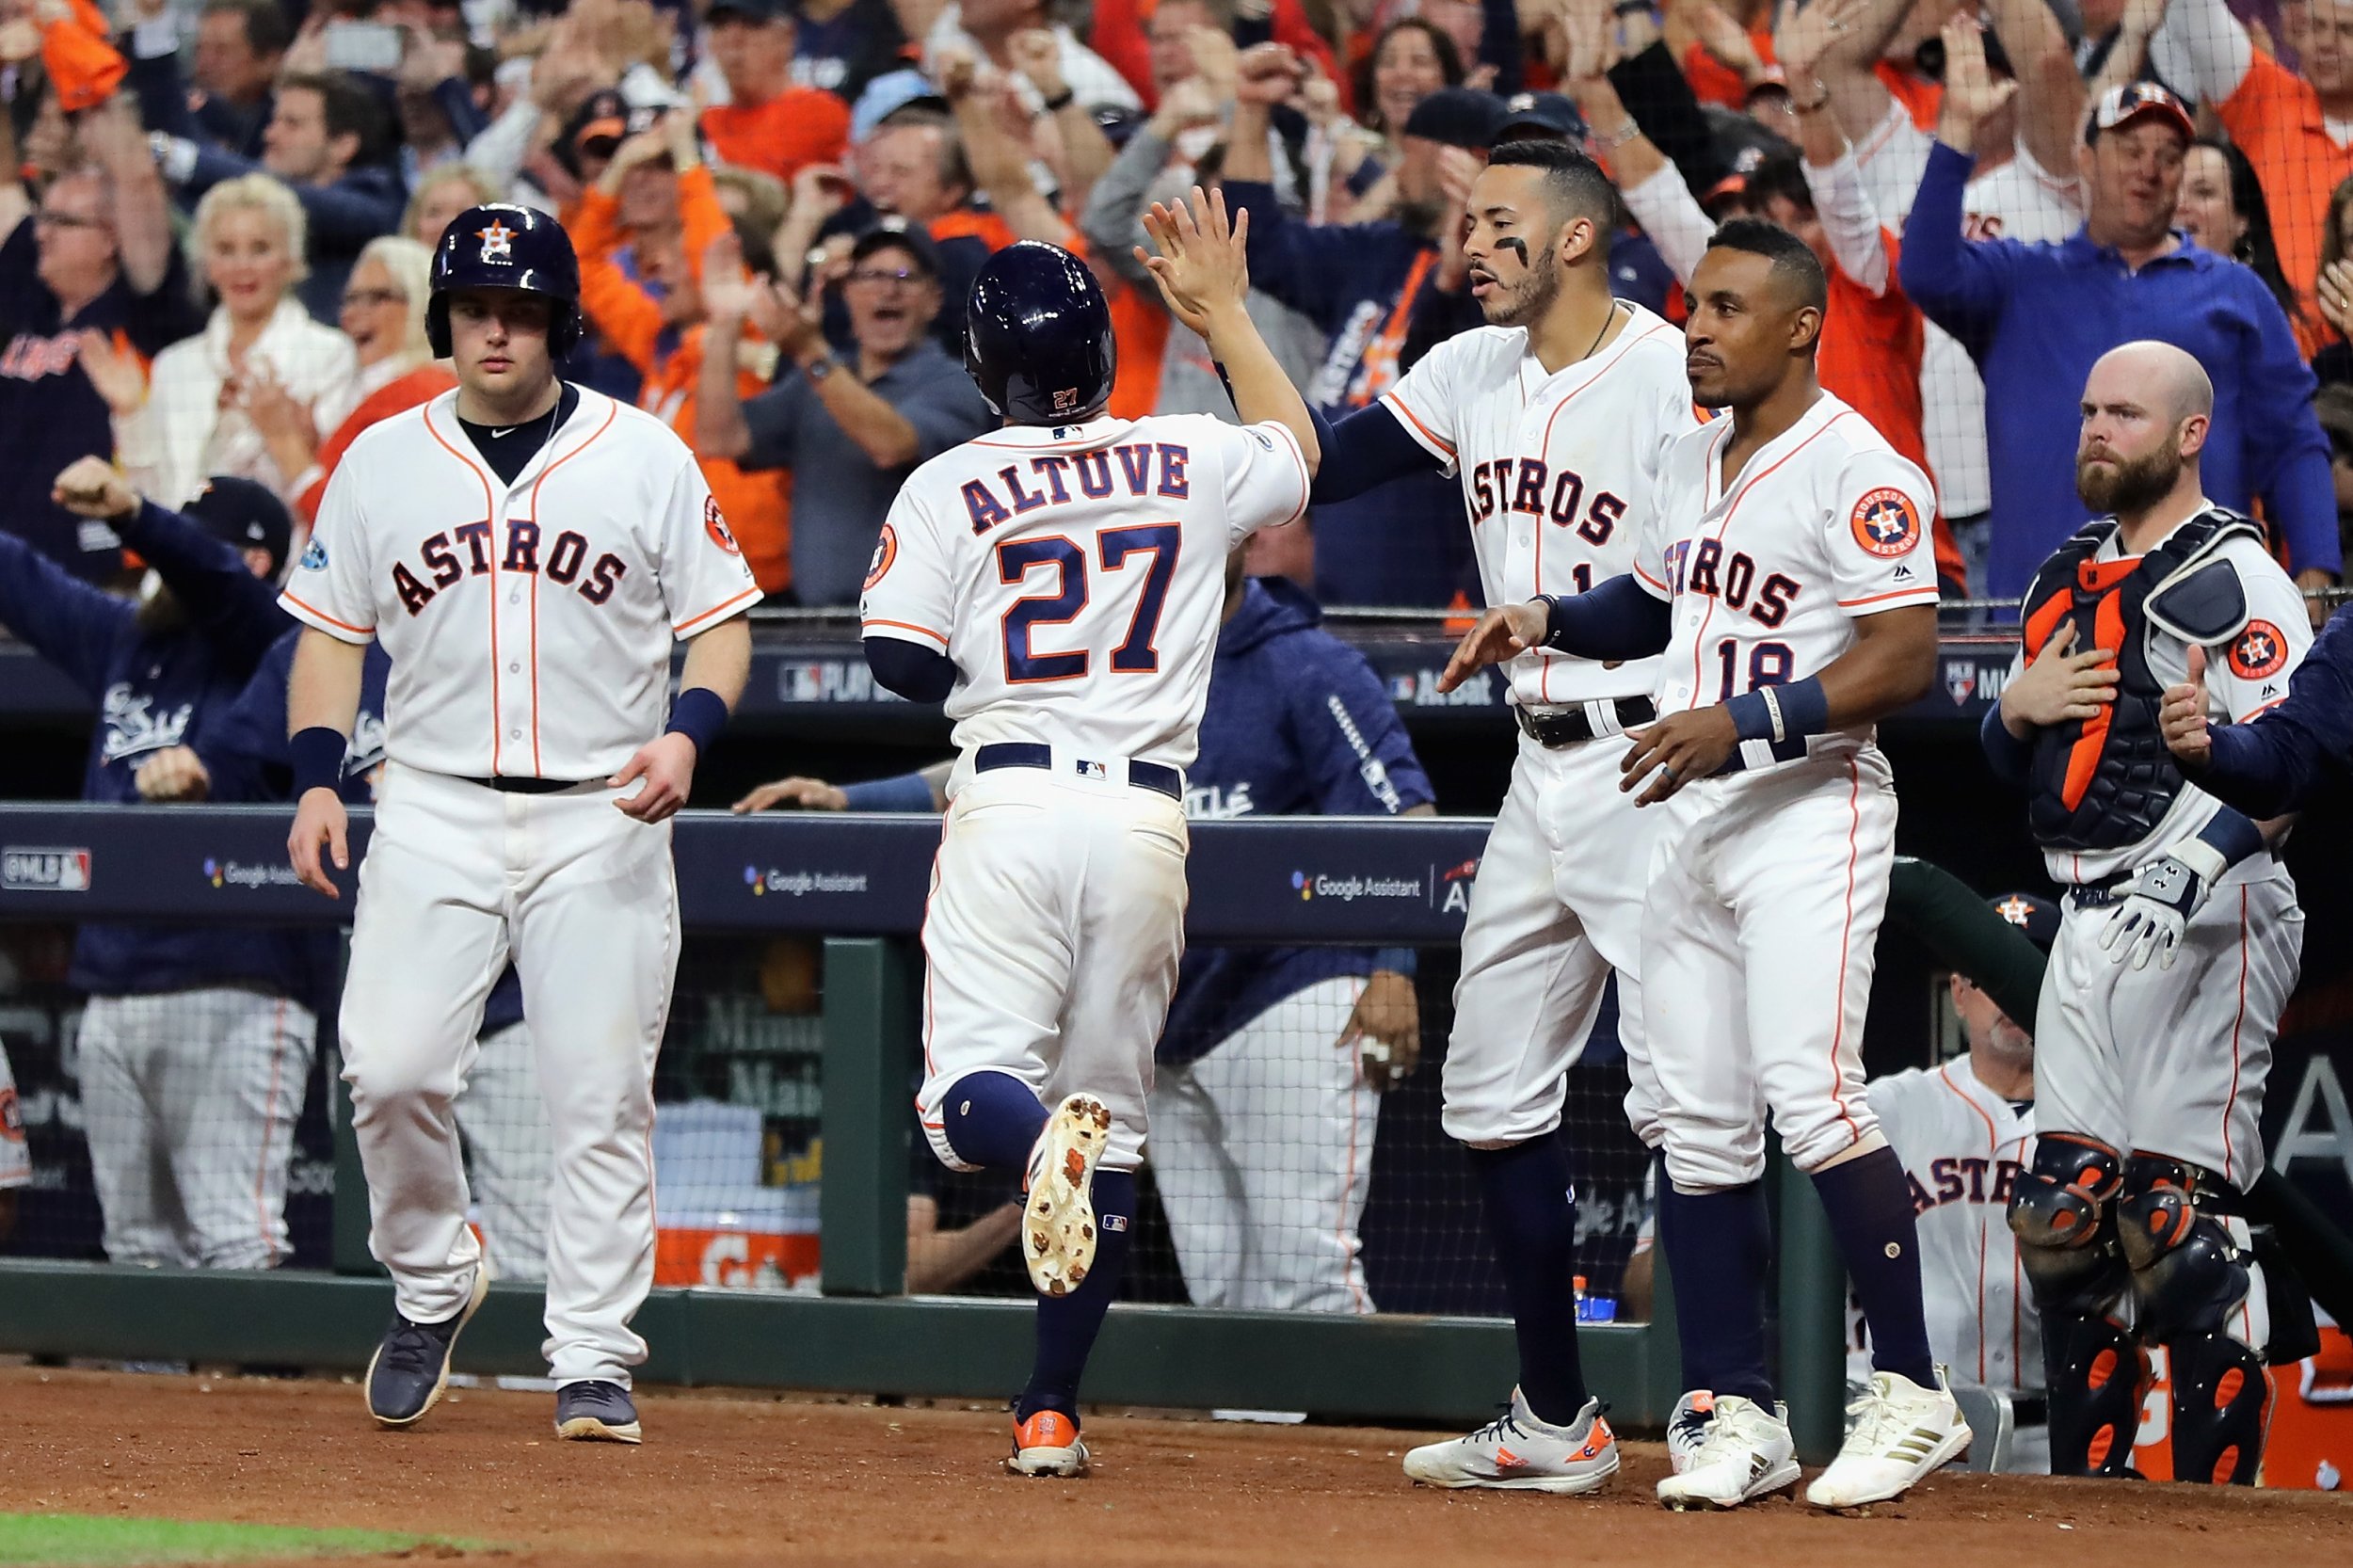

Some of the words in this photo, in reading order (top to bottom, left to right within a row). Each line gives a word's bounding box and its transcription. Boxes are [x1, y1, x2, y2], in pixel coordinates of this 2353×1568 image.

[1053, 387, 1077, 408] 27
[961, 442, 1190, 536] ALTUVE
[1468, 456, 1628, 546] STROS
[1854, 490, 1907, 520] HOUSTON
[1871, 508, 1903, 537] H
[1871, 531, 1917, 554] ASTROS
[392, 519, 627, 617] ASTROS
[1572, 564, 1593, 595] 1
[995, 521, 1181, 685] 27
[1719, 639, 1795, 696] 18
[7, 855, 59, 884] @MLB
[225, 861, 267, 889] Google
[766, 869, 813, 897] Google
[814, 872, 867, 892] Assistant
[1316, 874, 1363, 901] Google
[1364, 877, 1420, 896] Assistant
[1442, 881, 1475, 912] A
